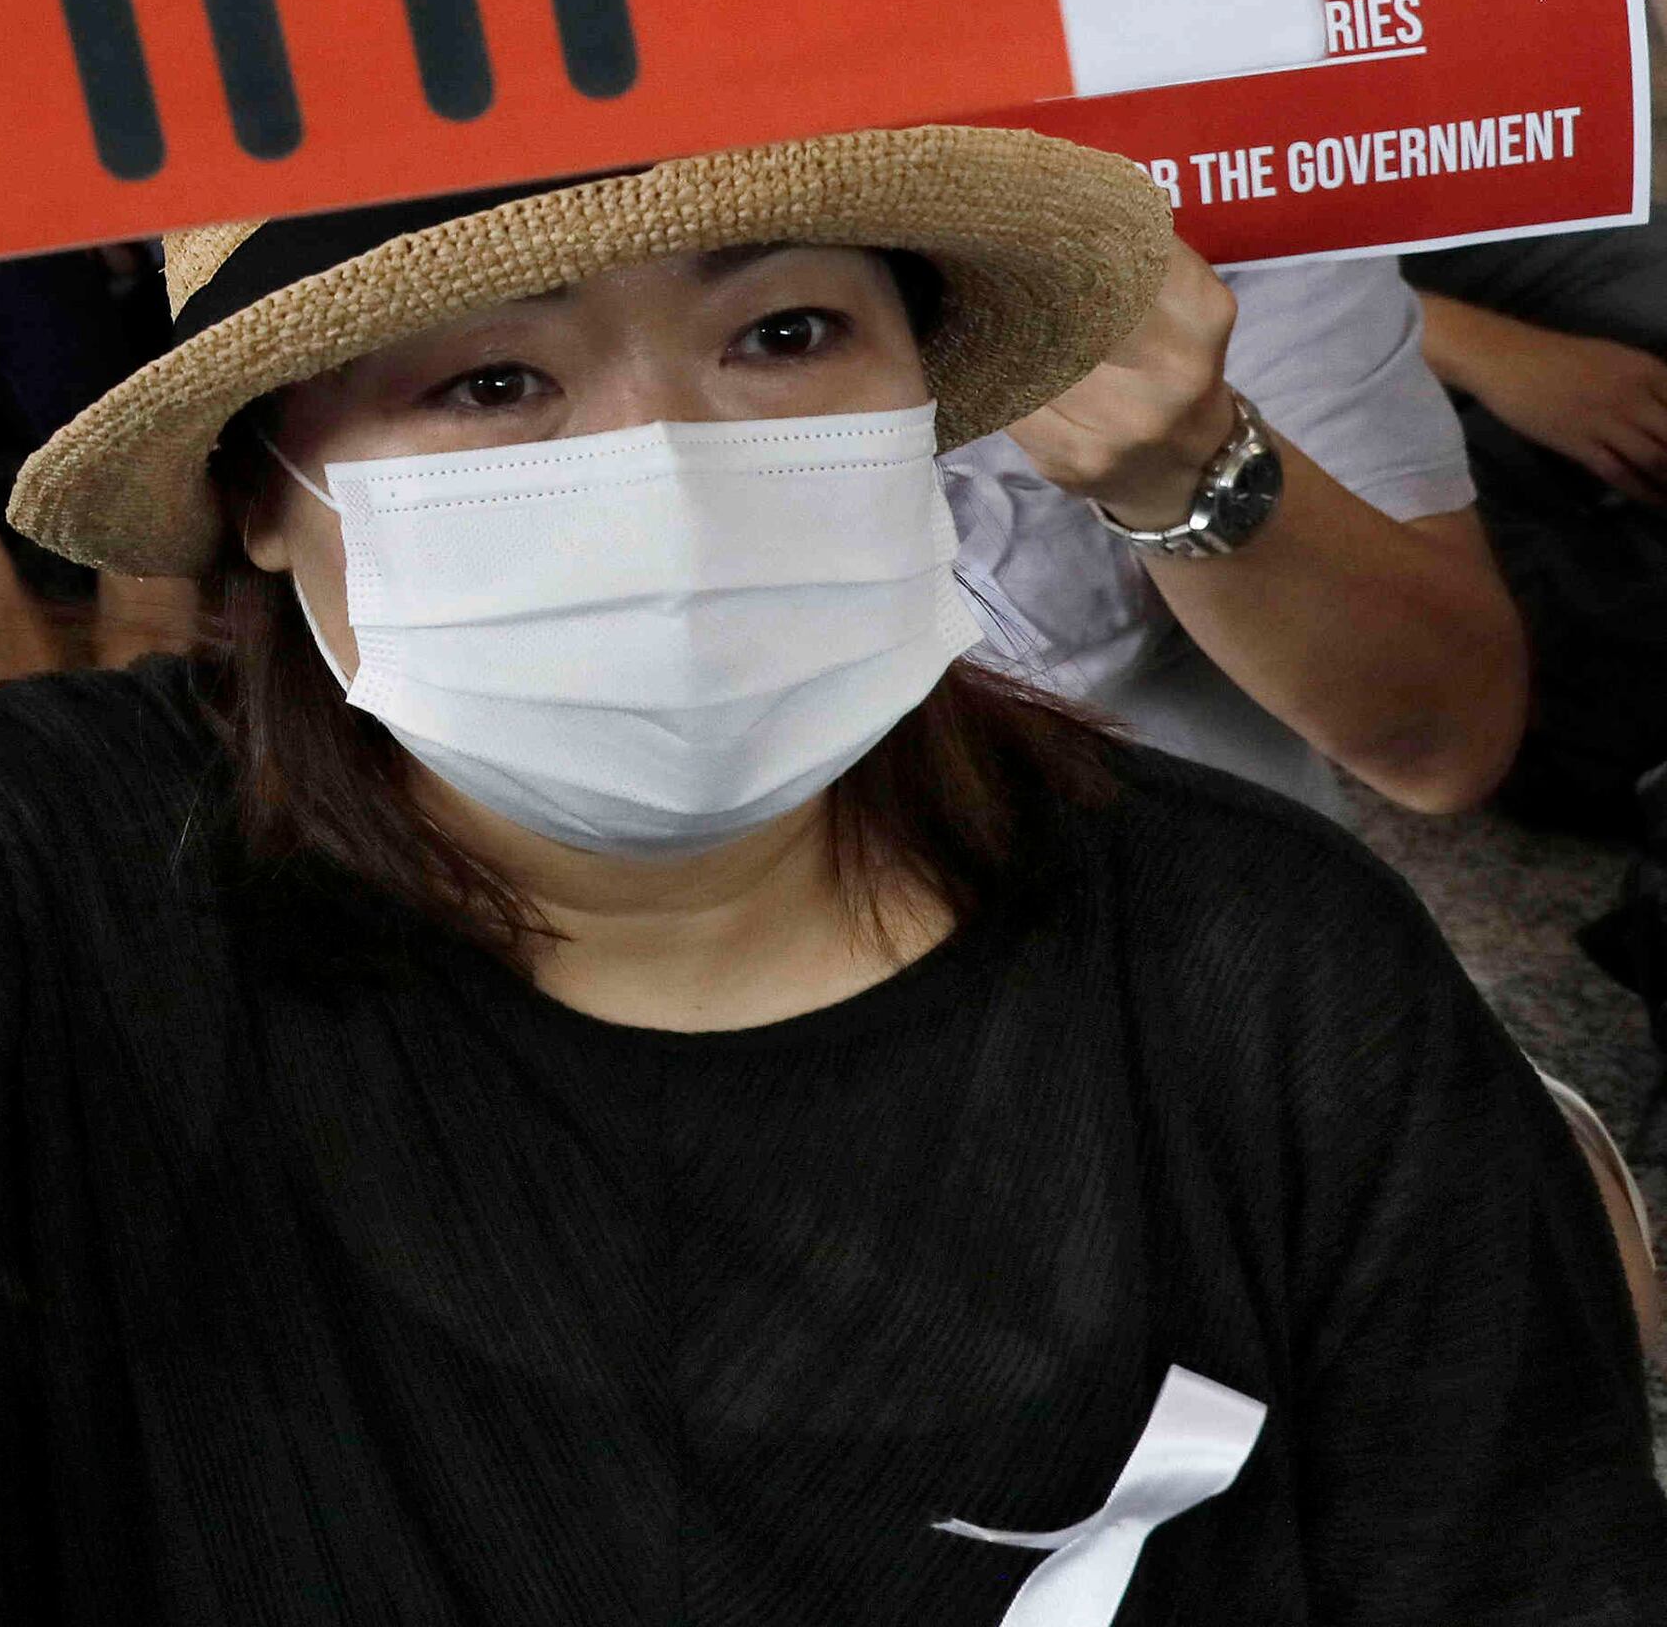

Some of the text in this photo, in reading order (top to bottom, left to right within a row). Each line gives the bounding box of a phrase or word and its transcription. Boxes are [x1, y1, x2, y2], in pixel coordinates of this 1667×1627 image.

[1134, 107, 1581, 209] R THE GOVERNMENT
